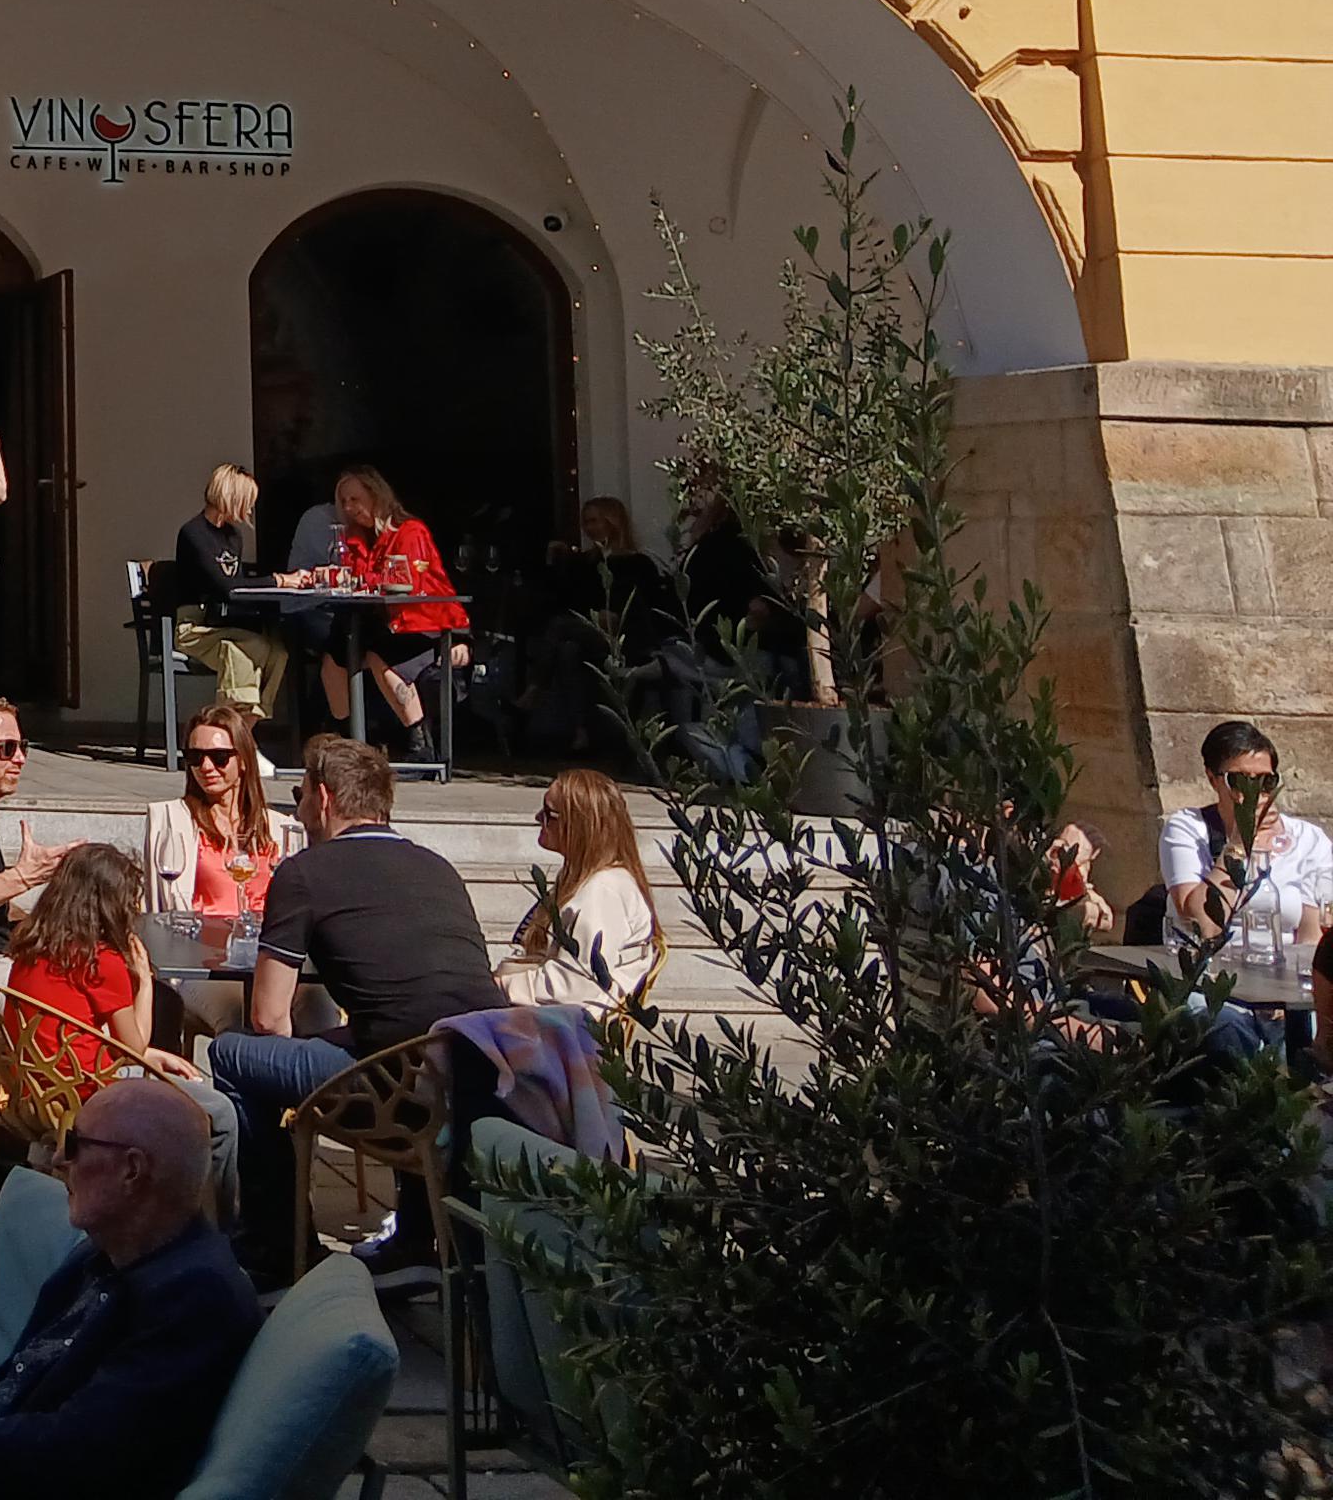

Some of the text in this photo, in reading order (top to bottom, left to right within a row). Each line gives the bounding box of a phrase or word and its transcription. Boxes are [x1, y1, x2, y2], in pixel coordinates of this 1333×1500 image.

[10, 154, 68, 171] CAFE
[165, 159, 209, 175] BAR
[229, 161, 291, 177] SHOP
